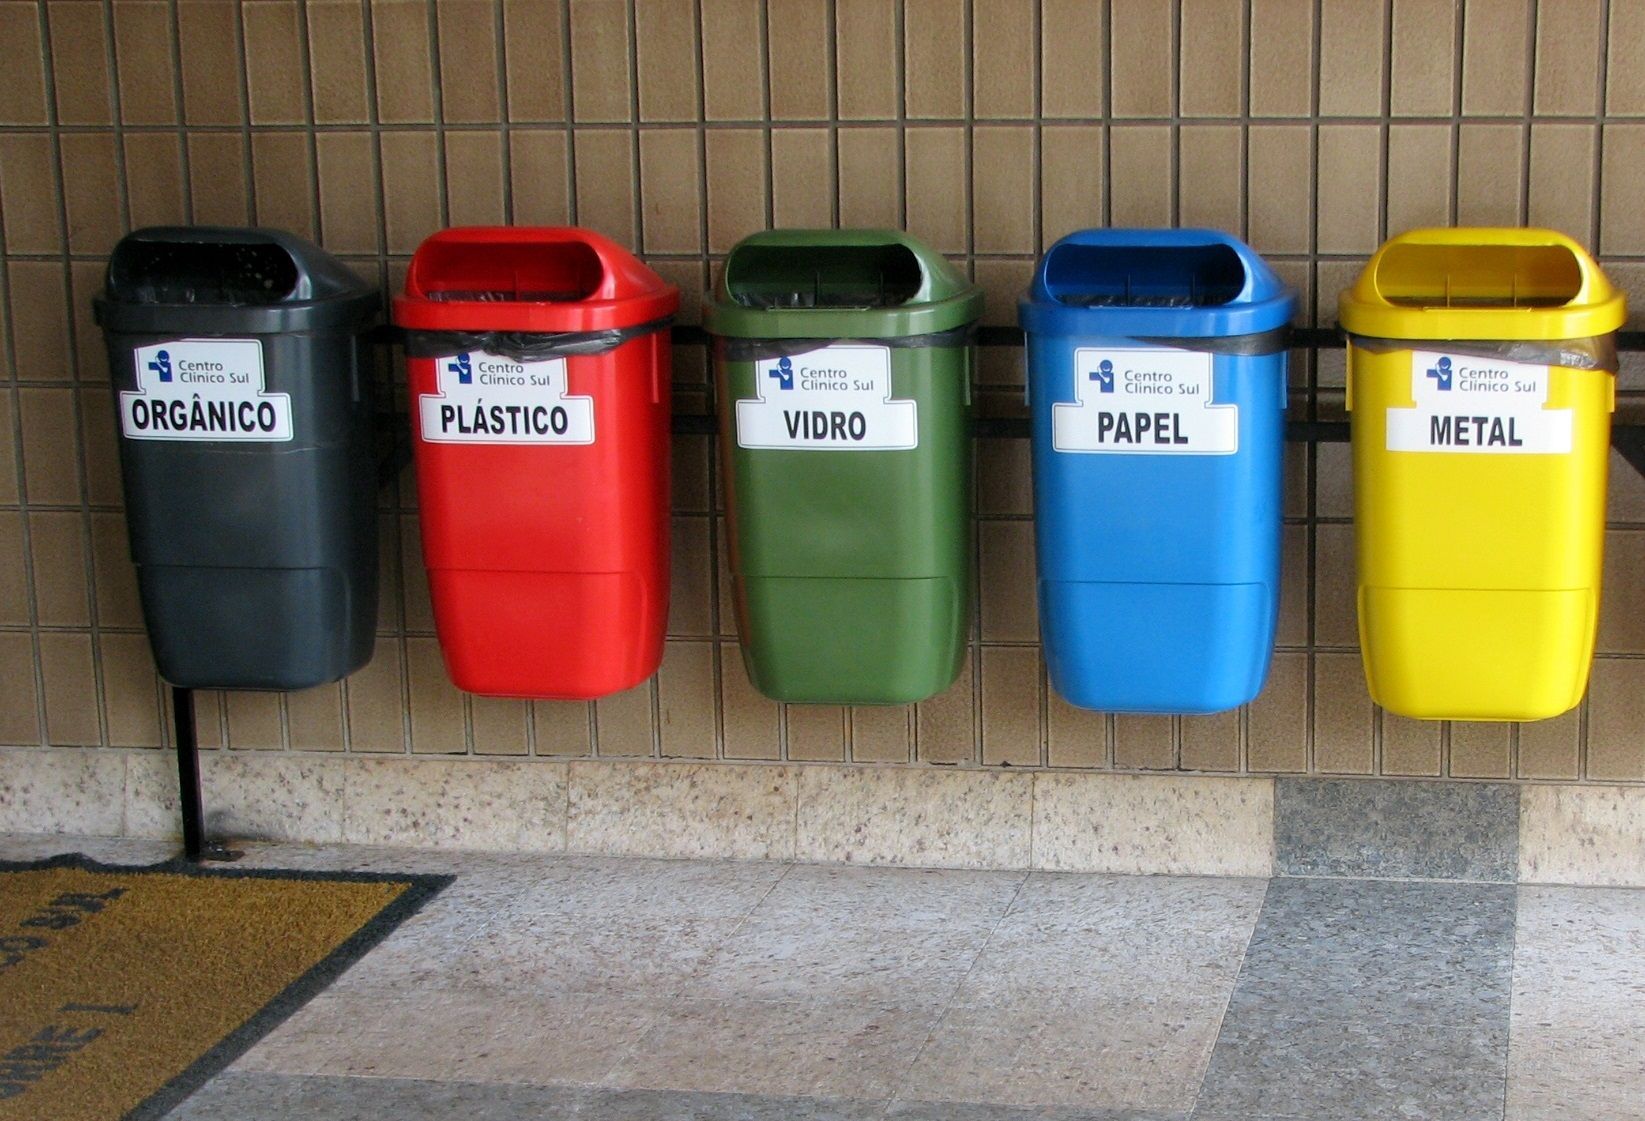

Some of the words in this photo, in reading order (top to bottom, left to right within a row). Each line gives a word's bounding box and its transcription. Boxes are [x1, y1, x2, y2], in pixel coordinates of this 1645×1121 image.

[178, 360, 224, 373] Centro
[478, 361, 525, 374] Centro
[800, 367, 847, 379] Centro
[230, 371, 249, 383] Sul
[532, 374, 551, 386] Sul
[1124, 369, 1173, 382] Centro
[1458, 367, 1509, 380] Centro
[853, 380, 874, 392] Sul
[1179, 382, 1200, 395] Sul
[1514, 380, 1536, 392] Sul
[132, 393, 276, 432] ORGÂNICO
[441, 398, 569, 435] PLÁSTICO
[783, 410, 866, 441] VIDRO
[1097, 411, 1189, 444] PAPEL
[1429, 415, 1523, 447] METAL
